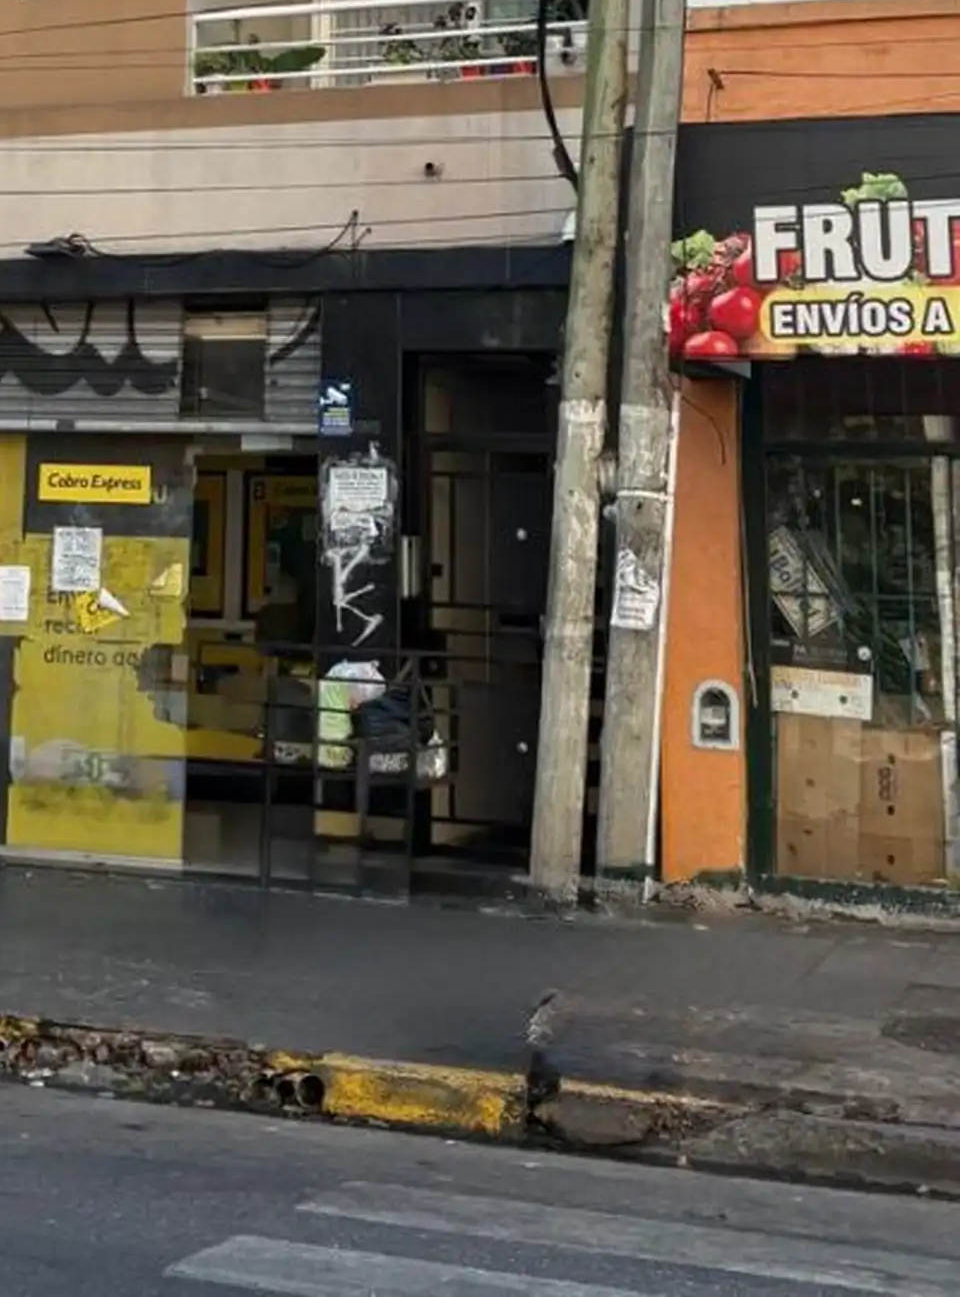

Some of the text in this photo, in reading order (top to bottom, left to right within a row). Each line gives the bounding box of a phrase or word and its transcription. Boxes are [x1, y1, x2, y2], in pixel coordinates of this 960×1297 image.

[754, 200, 960, 282] FRUT
[771, 293, 952, 336] ENVÍOS A
[47, 472, 143, 493] Cobro Express
[43, 645, 107, 666] dinero
